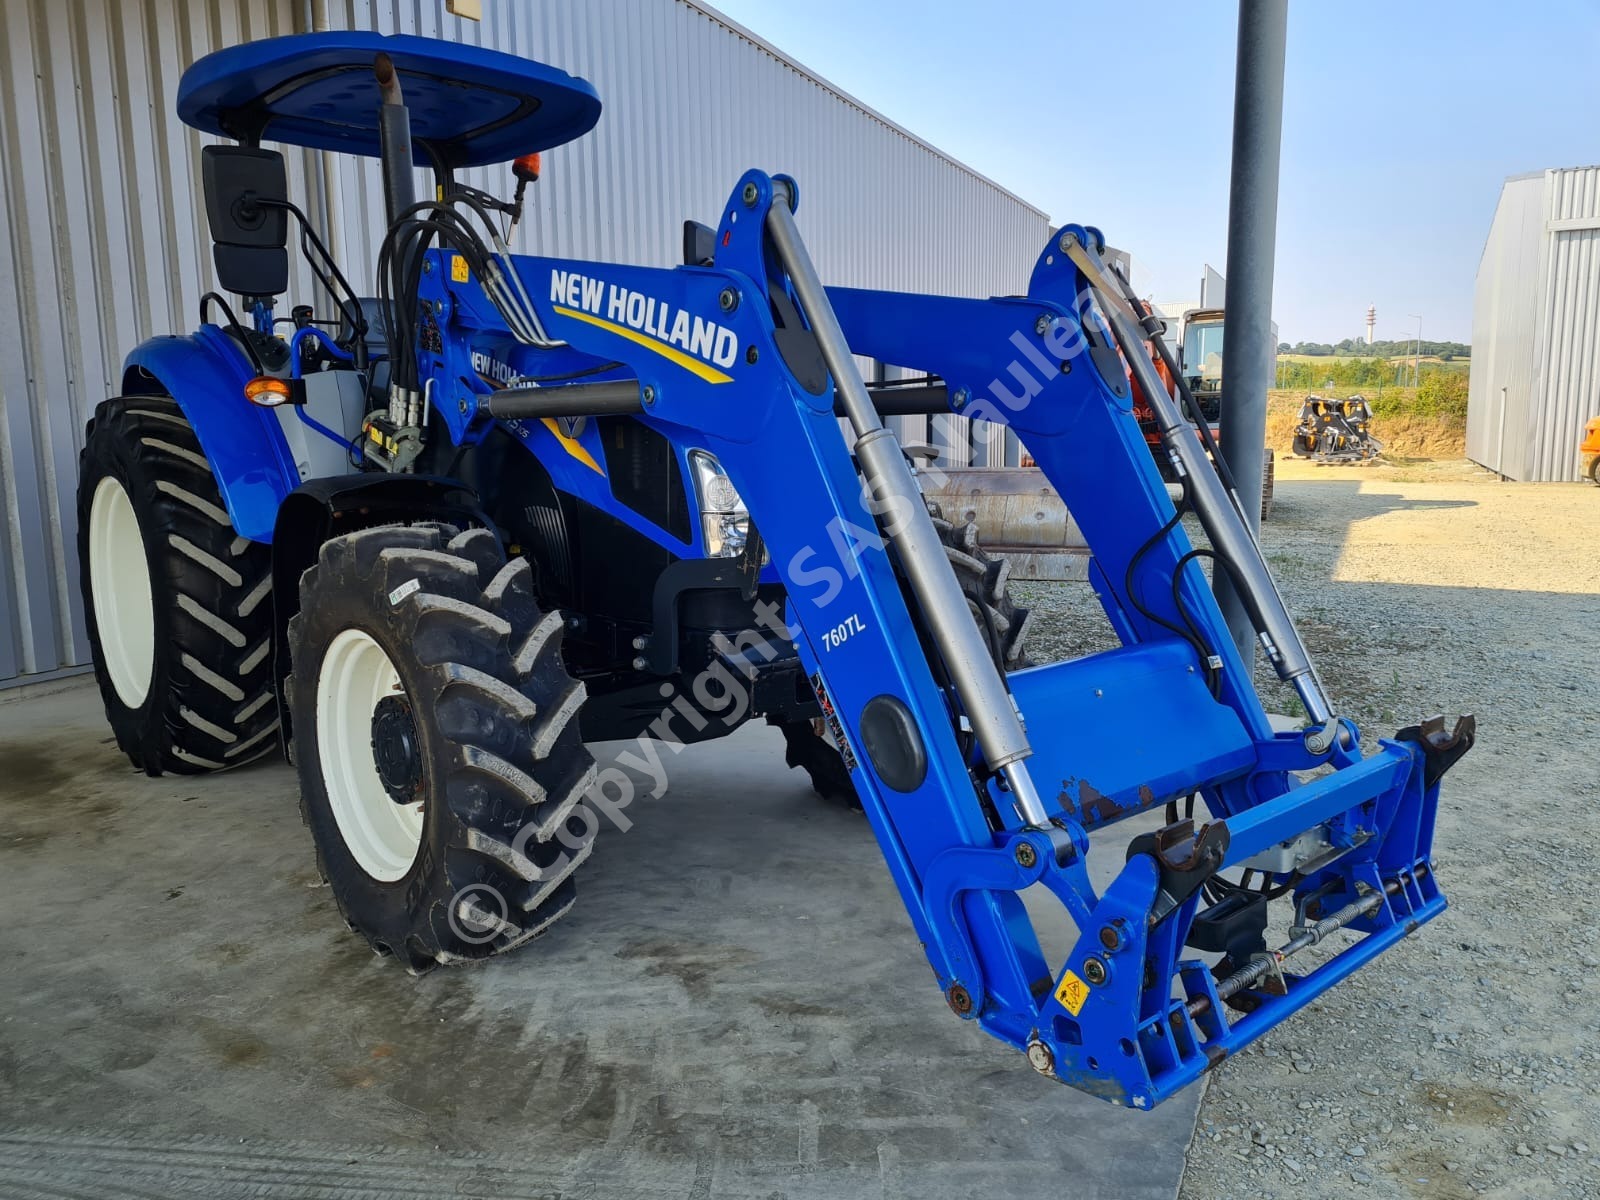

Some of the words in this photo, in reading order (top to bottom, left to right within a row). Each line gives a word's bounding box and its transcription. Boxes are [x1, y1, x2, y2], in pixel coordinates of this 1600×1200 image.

[550, 269, 604, 314] NEW
[608, 285, 738, 369] HOLLAND
[821, 614, 866, 652] 760TL
